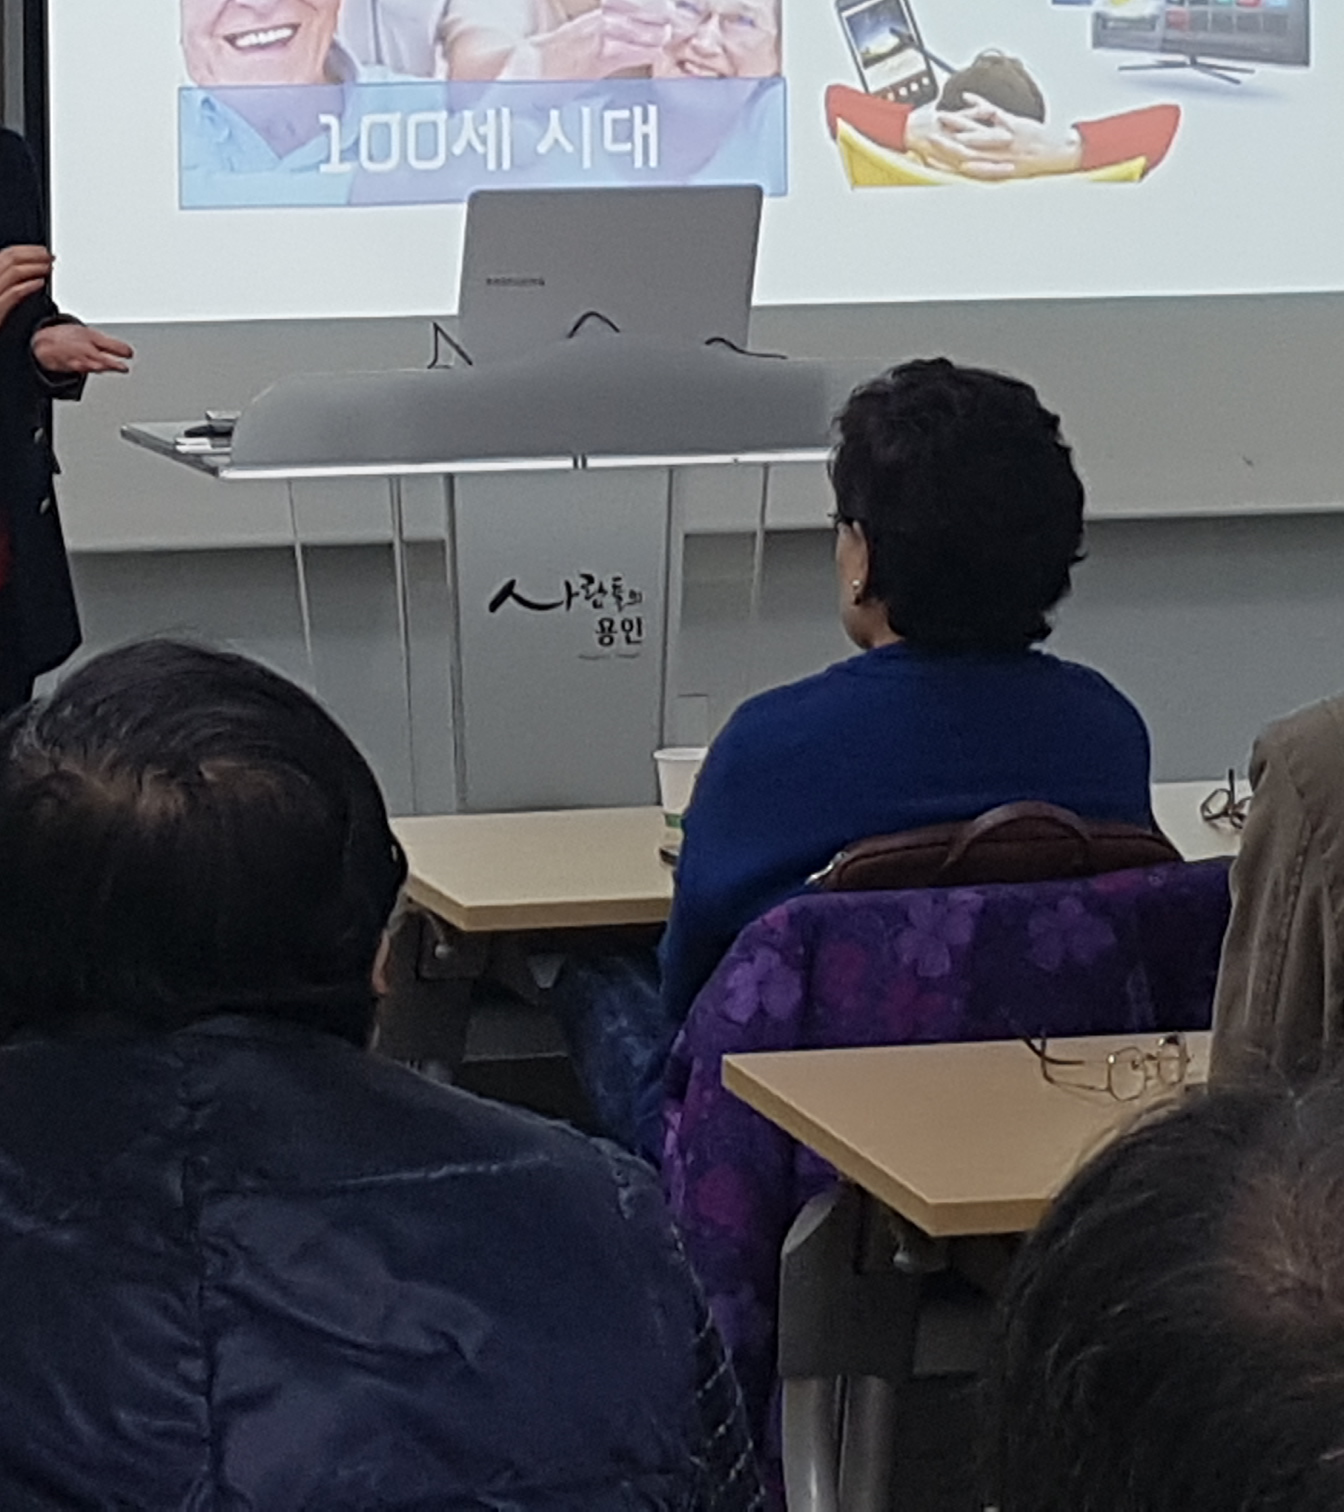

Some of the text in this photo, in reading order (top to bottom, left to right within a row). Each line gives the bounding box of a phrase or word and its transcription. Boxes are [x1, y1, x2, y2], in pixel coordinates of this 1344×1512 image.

[318, 105, 657, 174] 100세 시대
[594, 616, 643, 648] 용인
